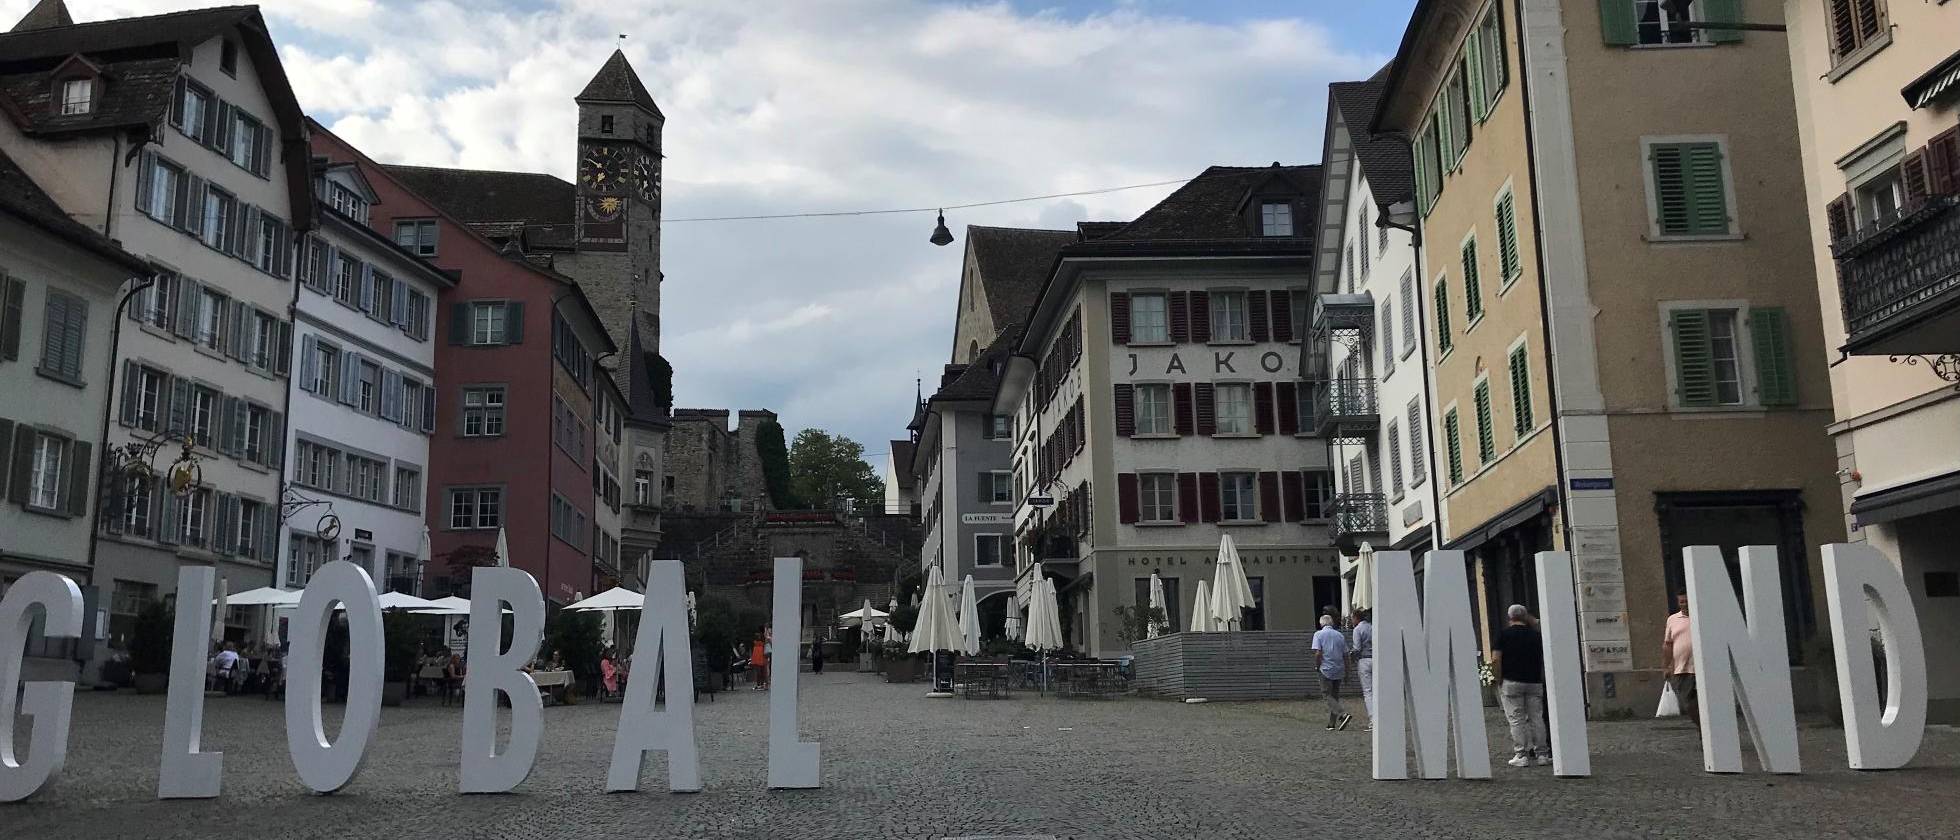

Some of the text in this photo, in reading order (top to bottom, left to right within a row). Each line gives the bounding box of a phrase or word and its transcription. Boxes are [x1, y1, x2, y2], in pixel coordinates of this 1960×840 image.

[1128, 557, 1187, 566] HOTEL
[0, 543, 1927, 803] GLOBAL MIND
